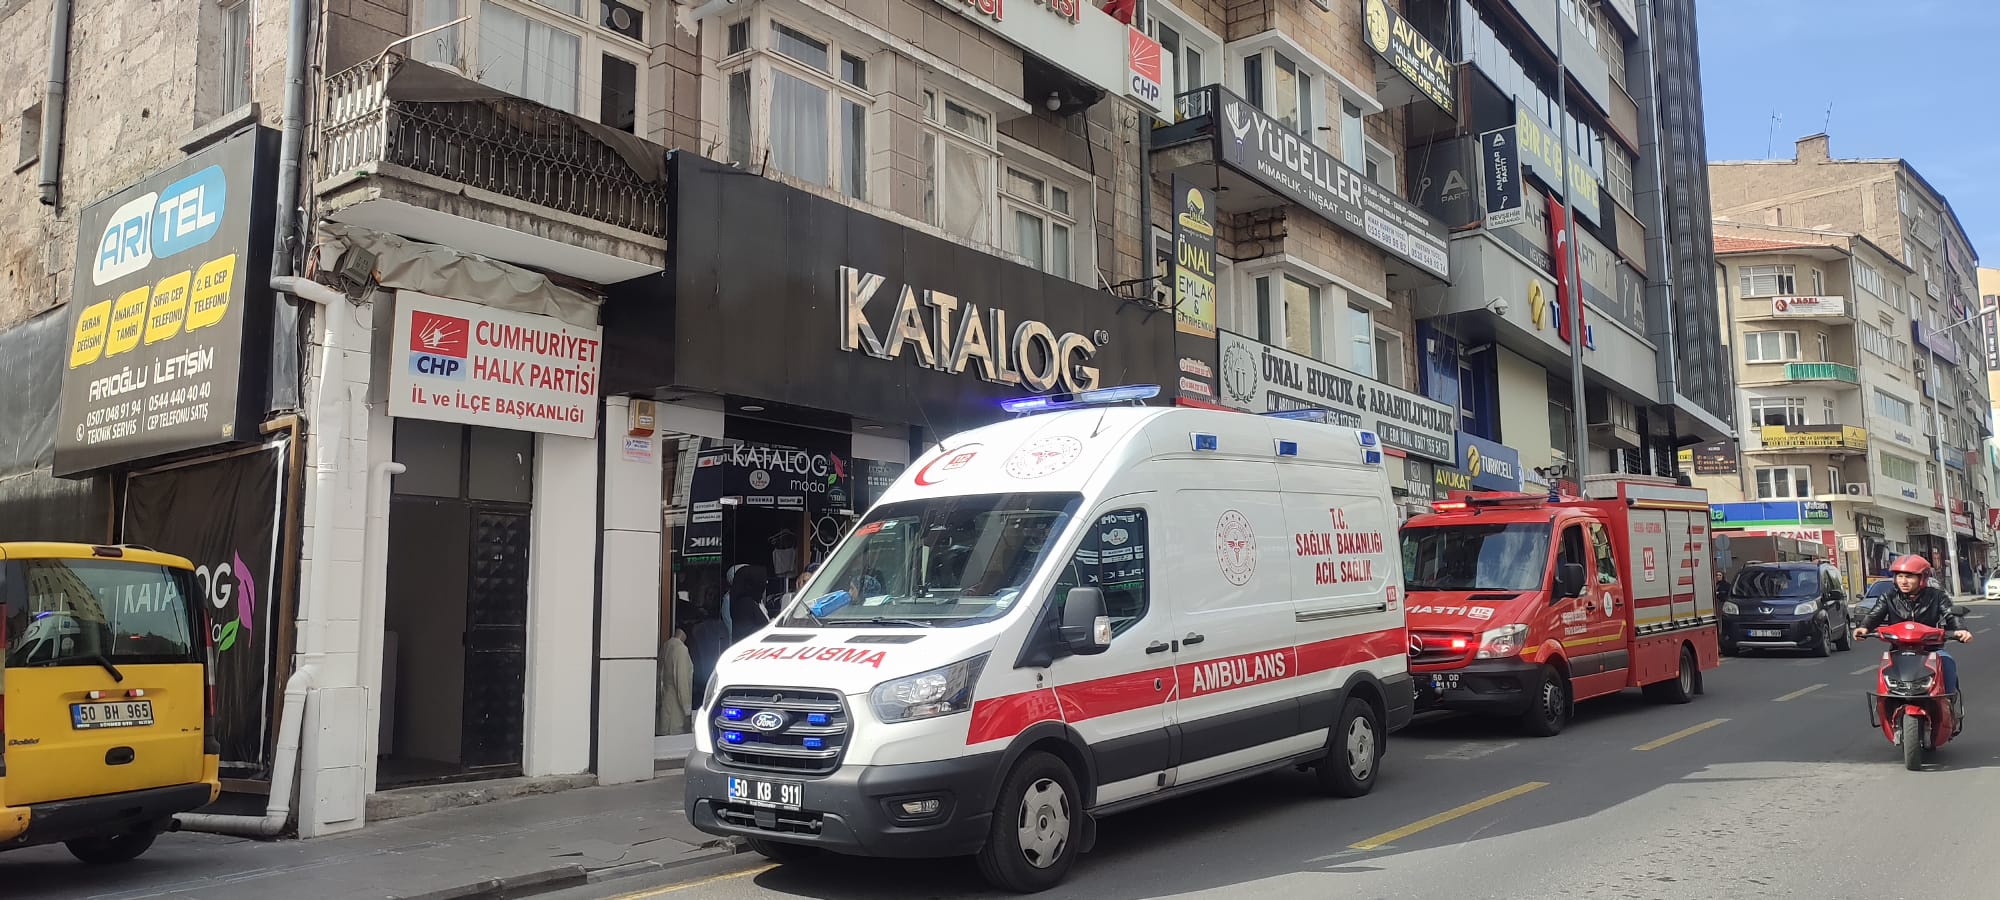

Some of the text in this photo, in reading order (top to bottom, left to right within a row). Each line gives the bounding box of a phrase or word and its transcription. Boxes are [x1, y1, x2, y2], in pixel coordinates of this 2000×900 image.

[1393, 16, 1453, 84] AVUKAT
[1132, 75, 1158, 101] CHP
[1252, 111, 1362, 210] YÜCELLER
[1494, 151, 1503, 191] ANAHTAR
[1258, 159, 1301, 193] MİMARLIK
[1308, 186, 1338, 212] İNŞAAT
[1345, 209, 1364, 229] GIDA
[1574, 163, 1599, 209] CAFE
[1178, 233, 1214, 277] ÜNAL
[204, 274, 212, 288] EL
[214, 269, 227, 286] CEP
[1179, 275, 1214, 303] EMLAK
[153, 286, 184, 307] SIFIR CEP
[194, 291, 228, 314] TELEFONU
[1194, 300, 1200, 315] &
[82, 315, 101, 331] EKRAN
[113, 301, 144, 323] ANAKART
[152, 308, 183, 330] TELEFONU
[116, 321, 138, 342] TAMİRİ
[475, 320, 598, 363] CUMHURİYET
[840, 265, 1100, 394] KATALOG
[88, 344, 214, 402] ARIOĞLU İLETİŞİM
[417, 355, 459, 377] CHP
[473, 355, 596, 396] HALK PARTİSİ
[149, 381, 211, 411] 0544 440 40 40
[412, 383, 584, 424] İL ve İLÇE BAŞKANLIĞI
[1261, 346, 1303, 392] ÜNAL
[1307, 367, 1354, 406] HUKUK
[1356, 384, 1367, 412] &
[1370, 388, 1453, 435] ARABULUCULUK
[86, 398, 142, 428] 0507 048 91 94
[147, 403, 209, 431] CEP TELEFONU SATIŞ
[733, 444, 827, 476] KATALOG
[1481, 455, 1513, 480] TURKCELL
[791, 479, 825, 493] moda
[1406, 480, 1431, 498] VUKAT
[1435, 469, 1471, 490] AVUKAT
[1329, 508, 1348, 530] T.C.
[1295, 529, 1383, 557] SAĞLIK BAKANLIĞI
[1315, 555, 1372, 585] ACİL SAĞLIK
[1192, 652, 1286, 694] AMBULANS
[81, 703, 149, 720] 50 BH 965
[756, 714, 777, 727] Ford
[735, 779, 799, 805] 50 KB 911
